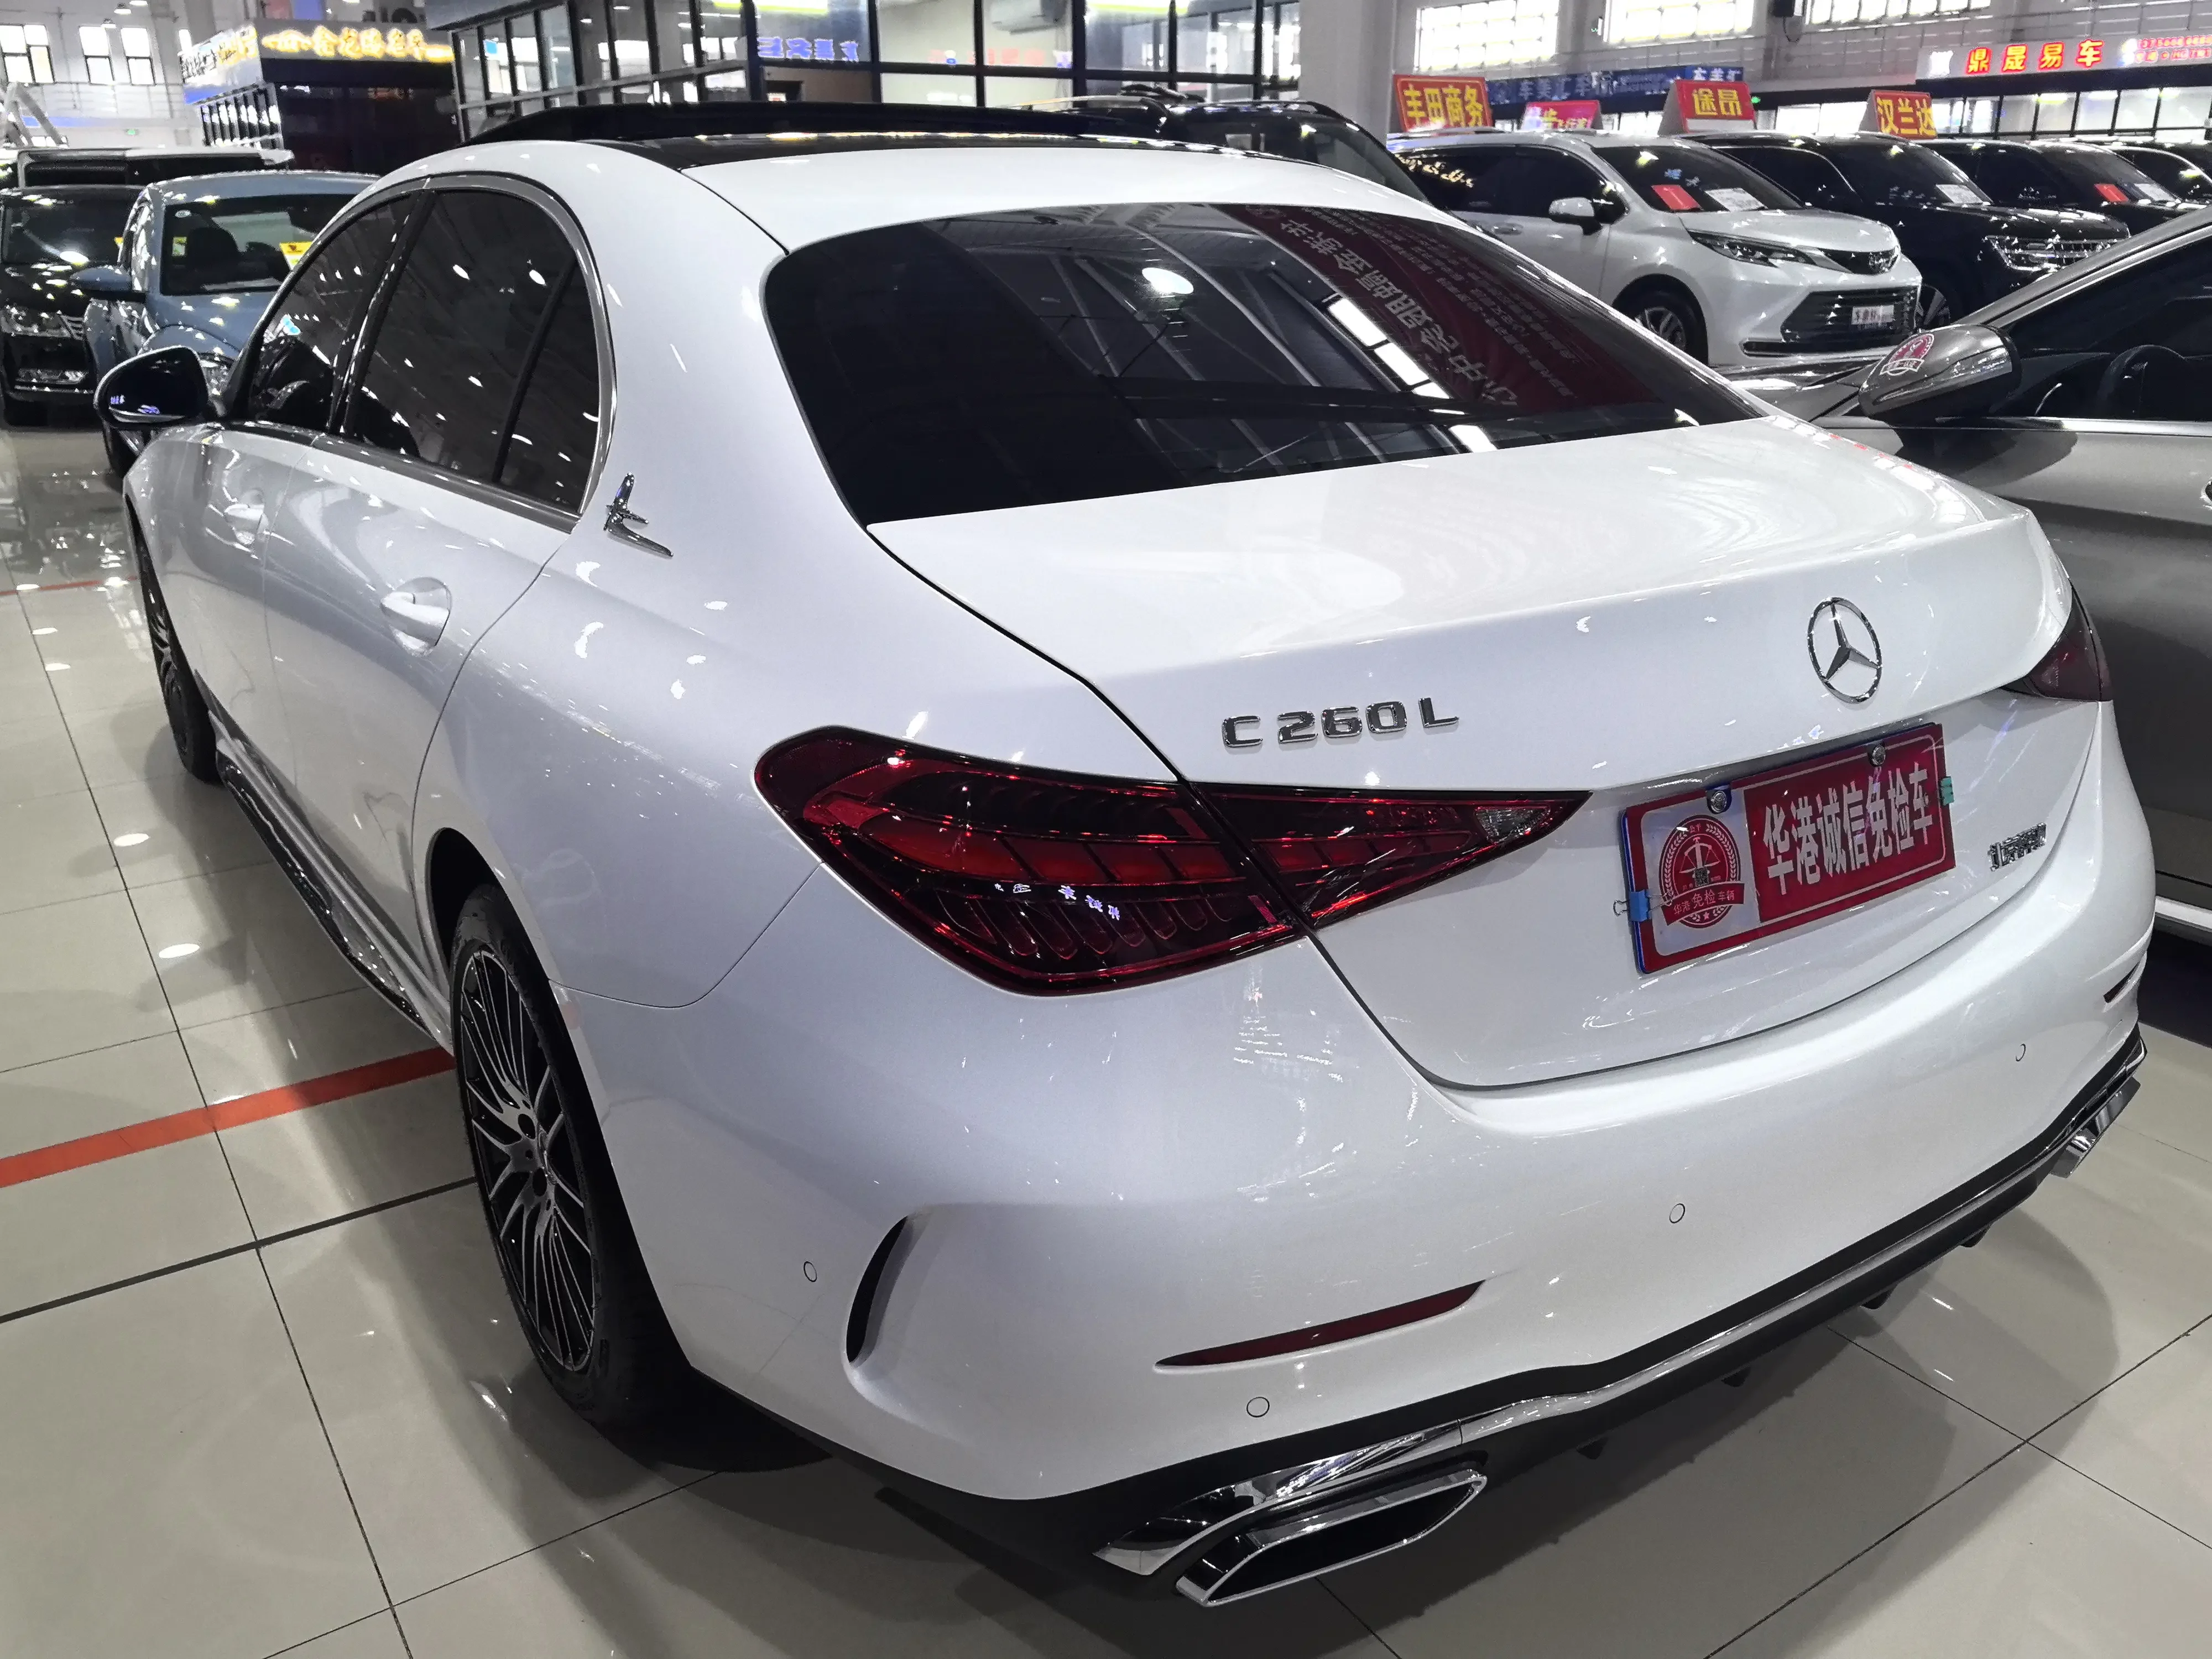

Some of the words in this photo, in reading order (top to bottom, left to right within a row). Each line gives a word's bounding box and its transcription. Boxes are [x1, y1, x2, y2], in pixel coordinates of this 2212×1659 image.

[1967, 39, 2104, 74] 鼎晟易车
[1403, 83, 1483, 127] 丰田商务
[1692, 88, 1742, 115] 途昂
[1876, 96, 1936, 135] 汉兰达
[1222, 715, 1262, 747] C
[1277, 701, 1407, 744] 260
[1418, 697, 1459, 728] L
[1763, 761, 1933, 895] 华港诚信免检车
